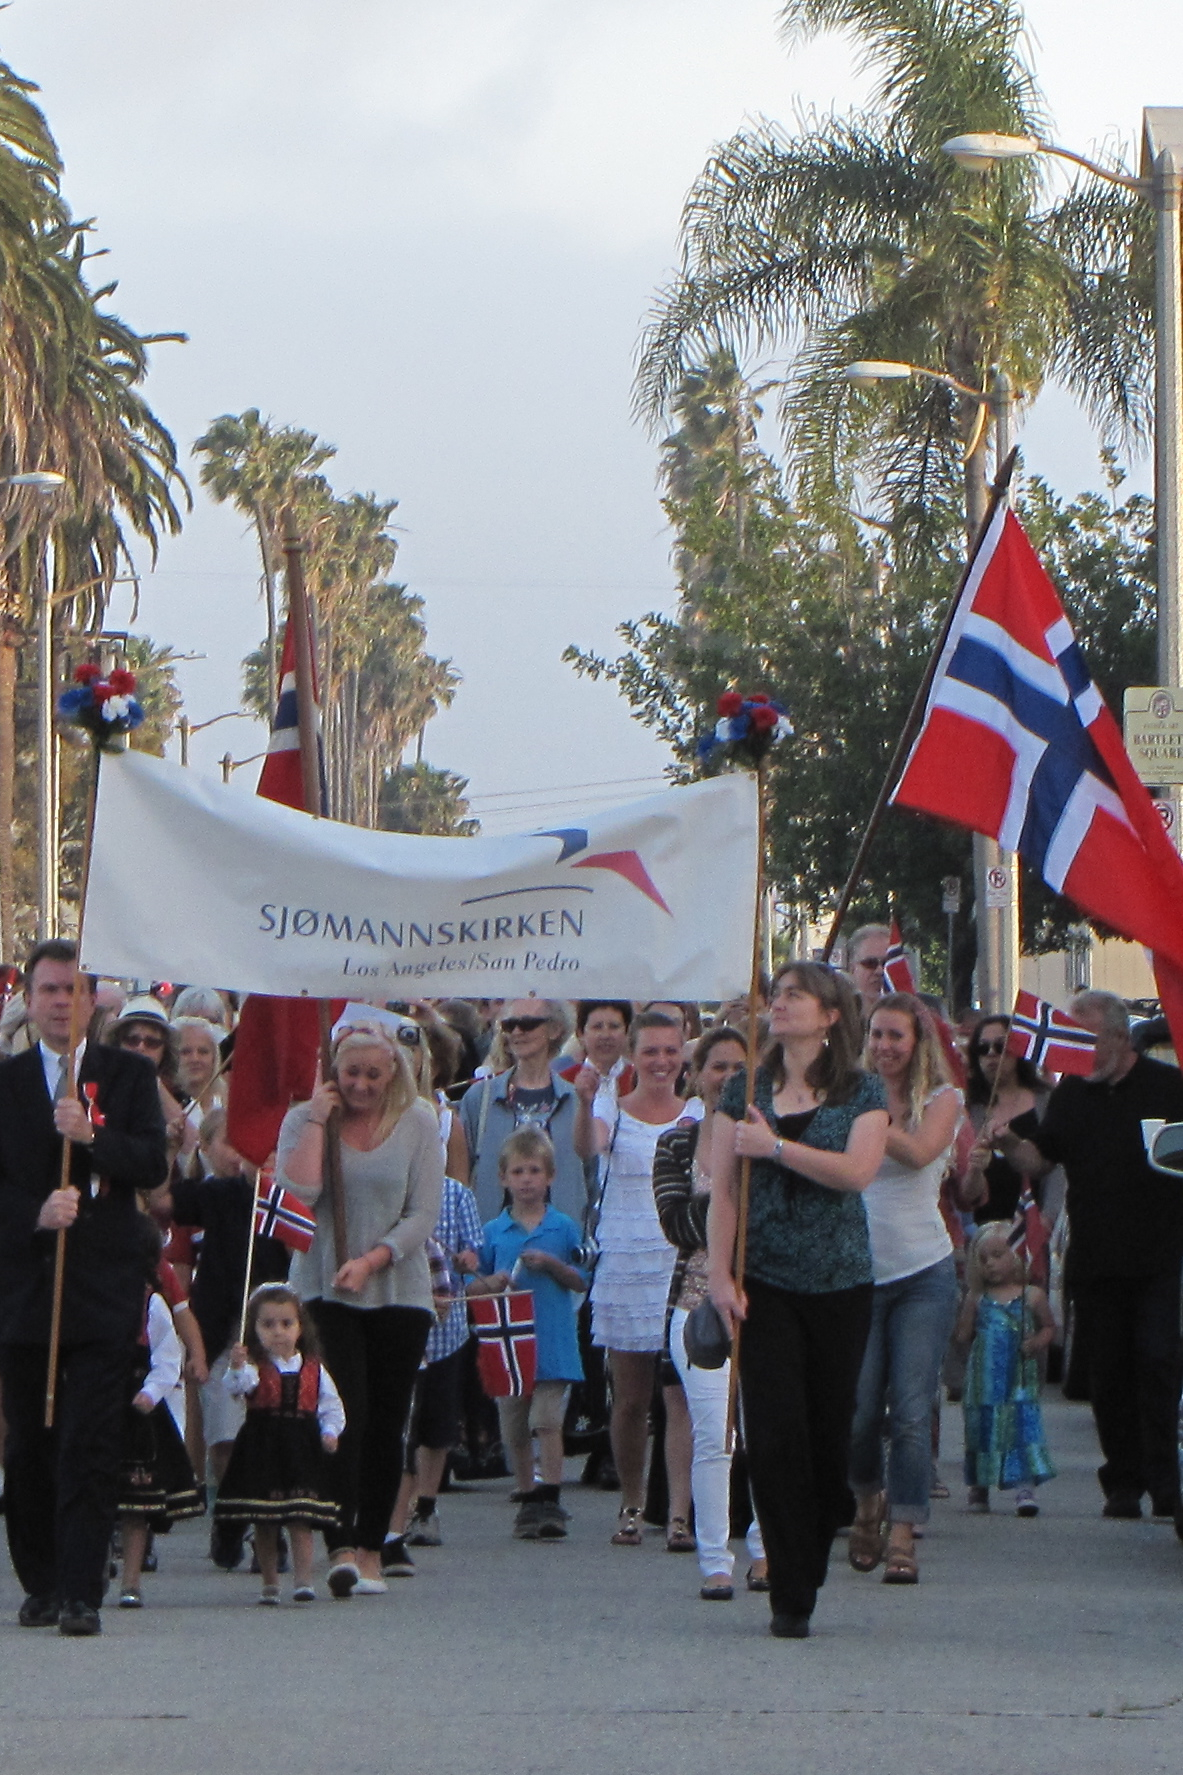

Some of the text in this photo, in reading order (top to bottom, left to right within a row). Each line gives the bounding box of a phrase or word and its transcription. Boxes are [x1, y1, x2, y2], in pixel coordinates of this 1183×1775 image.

[258, 903, 583, 949] SJØMANNSKIRKEN
[343, 951, 580, 980] Los Angeles/San Pedro
